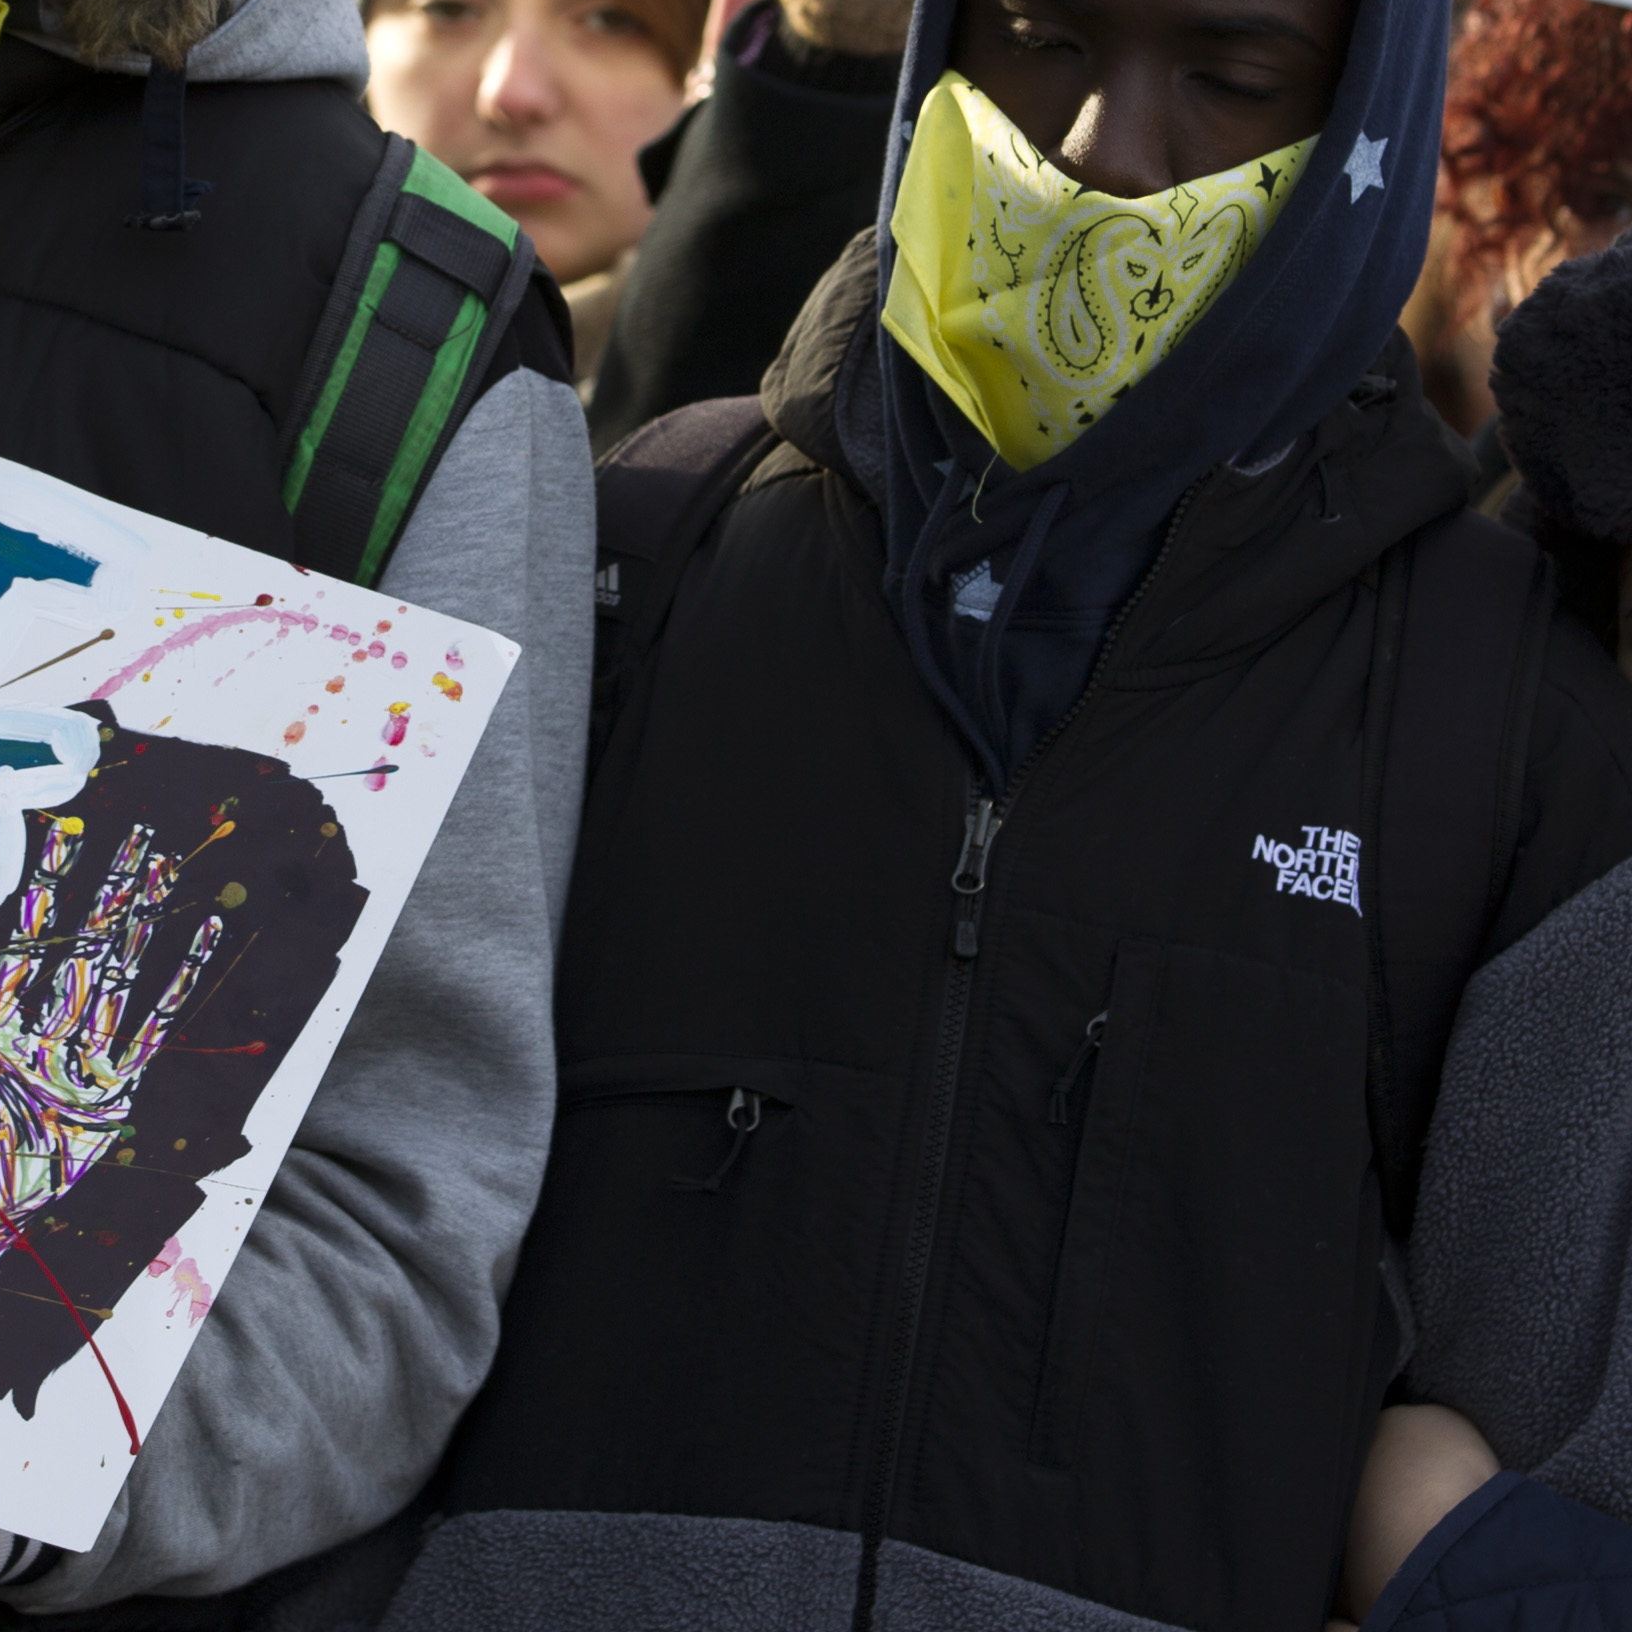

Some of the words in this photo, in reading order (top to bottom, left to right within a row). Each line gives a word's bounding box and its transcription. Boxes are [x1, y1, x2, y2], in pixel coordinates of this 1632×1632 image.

[1251, 834, 1357, 881] NORTH
[1301, 825, 1360, 858] THE
[1275, 868, 1354, 905] FACE
